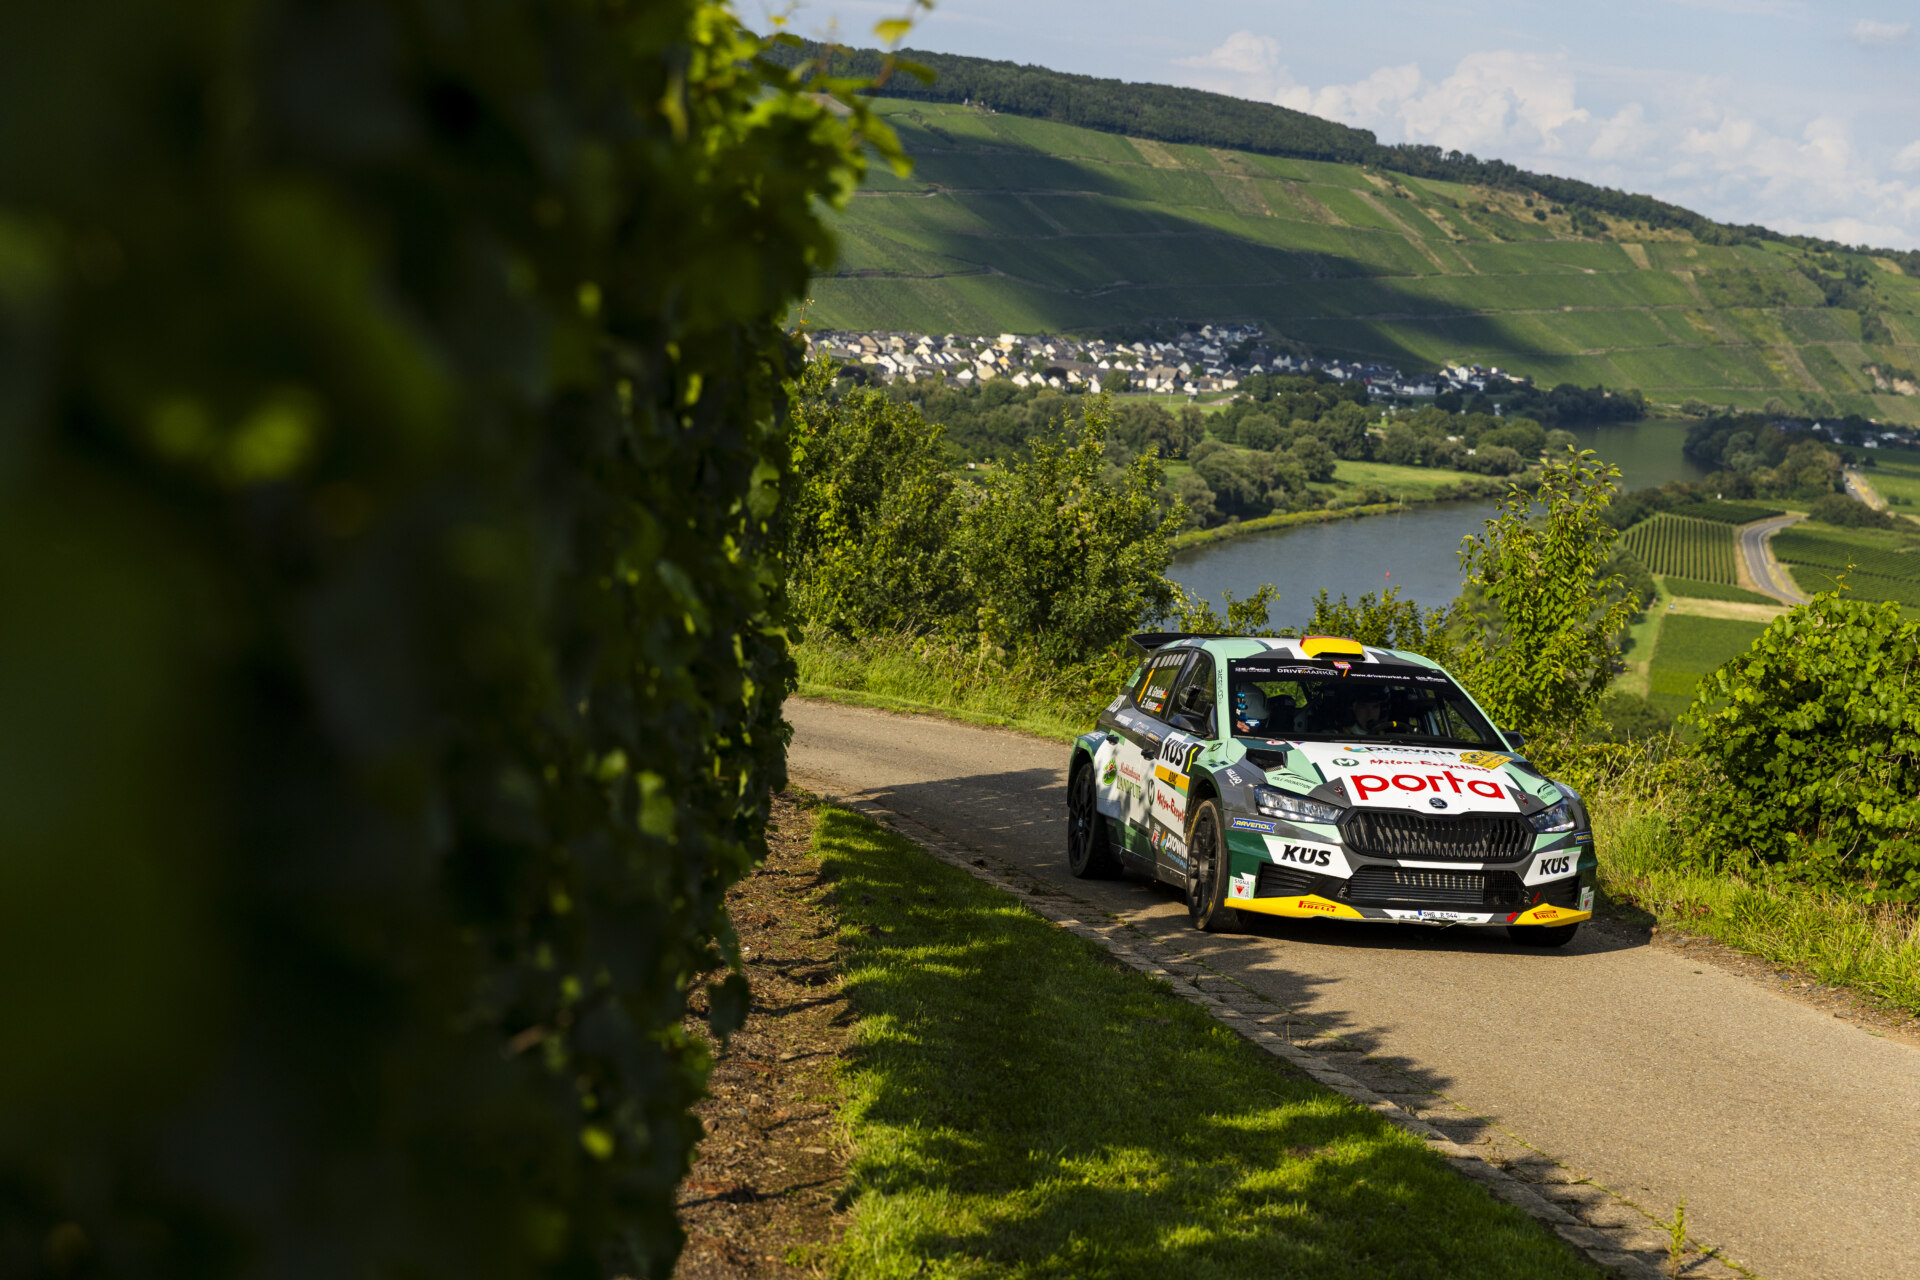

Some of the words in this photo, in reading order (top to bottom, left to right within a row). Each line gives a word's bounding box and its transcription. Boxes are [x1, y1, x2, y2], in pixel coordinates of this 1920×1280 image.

[1161, 738, 1189, 767] KÜS
[1350, 771, 1506, 800] porta
[1235, 820, 1271, 830] RAVENOL
[1281, 844, 1332, 867] KÜS
[1540, 856, 1570, 875] KÜS
[1298, 900, 1337, 913] PIRELLI
[1532, 910, 1559, 920] PIRELLI
